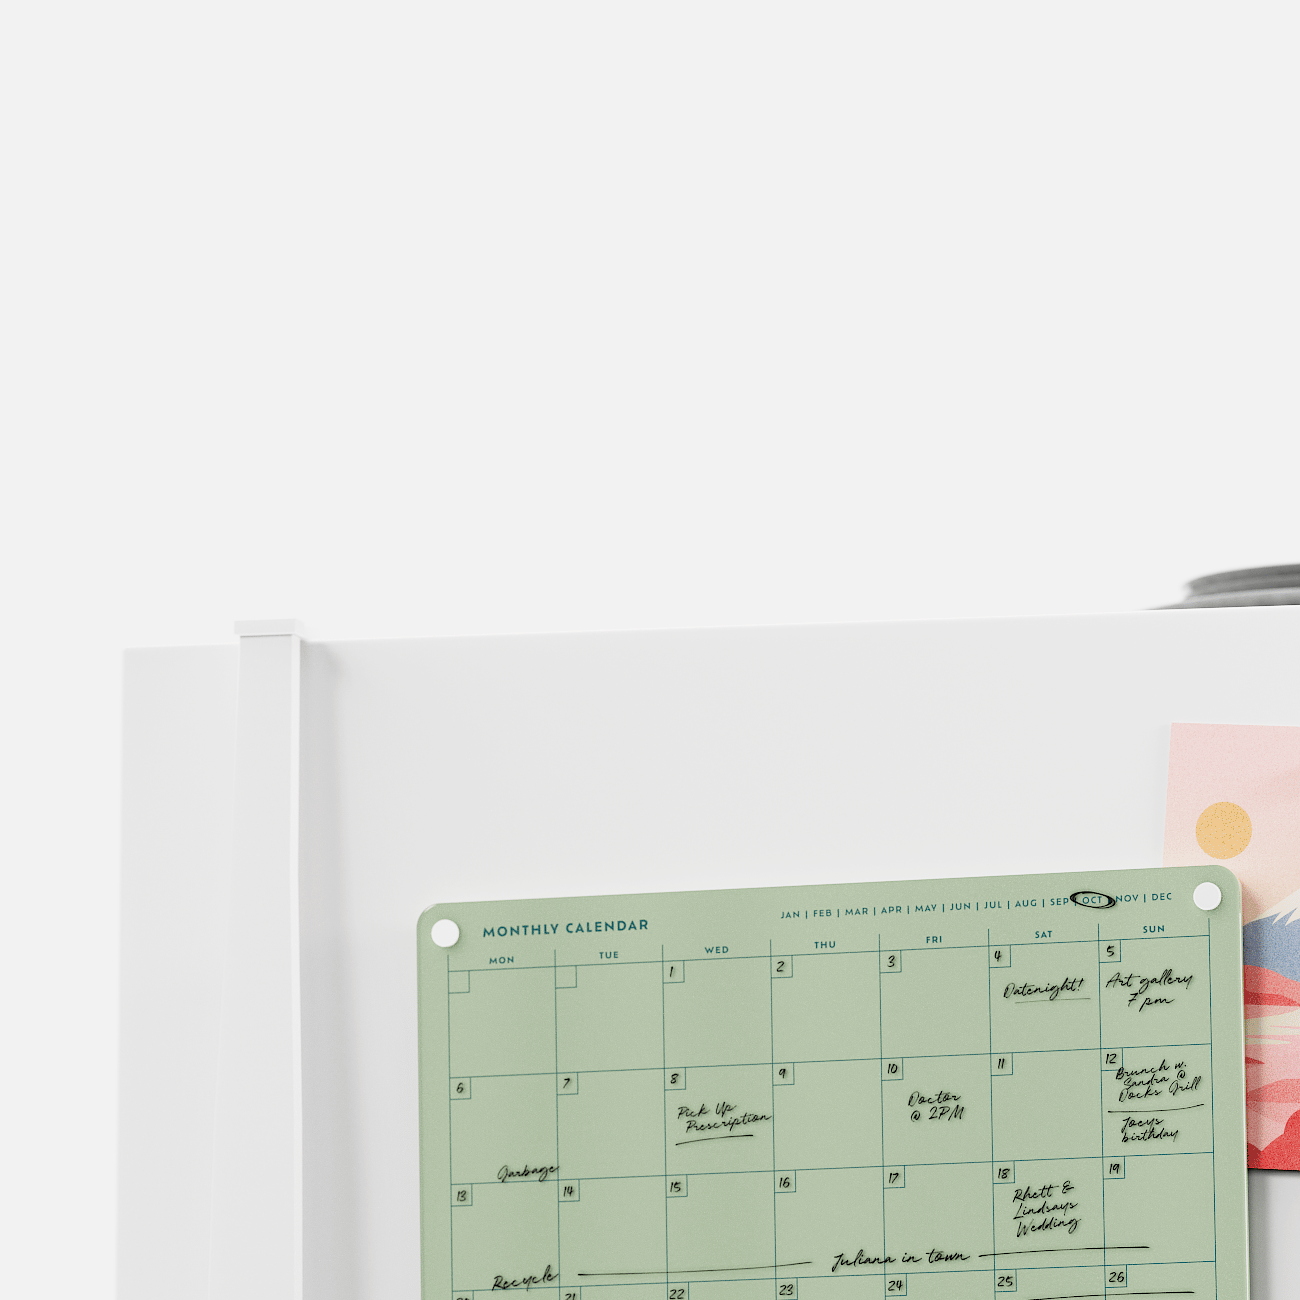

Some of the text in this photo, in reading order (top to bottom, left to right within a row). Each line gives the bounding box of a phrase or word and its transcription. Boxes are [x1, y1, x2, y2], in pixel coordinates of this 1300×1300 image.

[781, 892, 1172, 919] JAN FEB MAR APR MAY JUN JUL AUG SEP OCT NOV DEC
[483, 919, 649, 938] MONTHLY CALENDAR
[1035, 930, 1052, 939] SAT
[1143, 925, 1165, 934] SUN
[814, 941, 836, 949] THU
[926, 935, 942, 944] FRI
[599, 951, 619, 960] TUE
[705, 946, 729, 954] WED
[993, 950, 1003, 964] 4
[1106, 944, 1116, 958] 5
[489, 956, 514, 965] MON
[776, 960, 785, 974] 2
[887, 954, 896, 968] 3
[668, 965, 675, 978] 1
[1004, 978, 1084, 1000] Datenight!
[1106, 971, 1193, 994] Art gallery
[1127, 992, 1174, 1012] 7 pm
[997, 1057, 1006, 1070] 11
[1105, 1052, 1117, 1065] 12
[777, 1067, 787, 1080] 9
[886, 1062, 899, 1075] 10
[1115, 1063, 1171, 1080] Brunch
[563, 1078, 572, 1090] 7
[669, 1073, 679, 1086] 8
[1123, 1071, 1186, 1090] Sandra @
[456, 1082, 465, 1094] 6
[1118, 1077, 1202, 1103] Docks Grill
[908, 1091, 961, 1107] Doctor
[678, 1102, 737, 1120] Pick Up
[911, 1107, 965, 1122] @ 2PM
[686, 1112, 772, 1133] Prescription
[1122, 1116, 1165, 1134] Joeys
[1122, 1128, 1179, 1143] birthday
[498, 1164, 559, 1182] Garbage
[997, 1167, 1011, 1180] 18
[1108, 1162, 1121, 1176] 19
[778, 1176, 791, 1189] 16
[888, 1171, 899, 1184] 17
[563, 1185, 575, 1198] 14
[669, 1181, 682, 1193] 15
[1013, 1181, 1074, 1203] Rhett &
[456, 1189, 467, 1202] 13
[1013, 1200, 1078, 1219] Lindsays
[1017, 1217, 1081, 1237] Wedding
[832, 1248, 970, 1272] Juliana in town
[492, 1265, 559, 1291] Recycle
[997, 1275, 1014, 1288] 25
[1108, 1270, 1126, 1284] 26
[779, 1283, 795, 1297] 23
[887, 1279, 904, 1293] 24
[669, 1288, 685, 1300] 22
